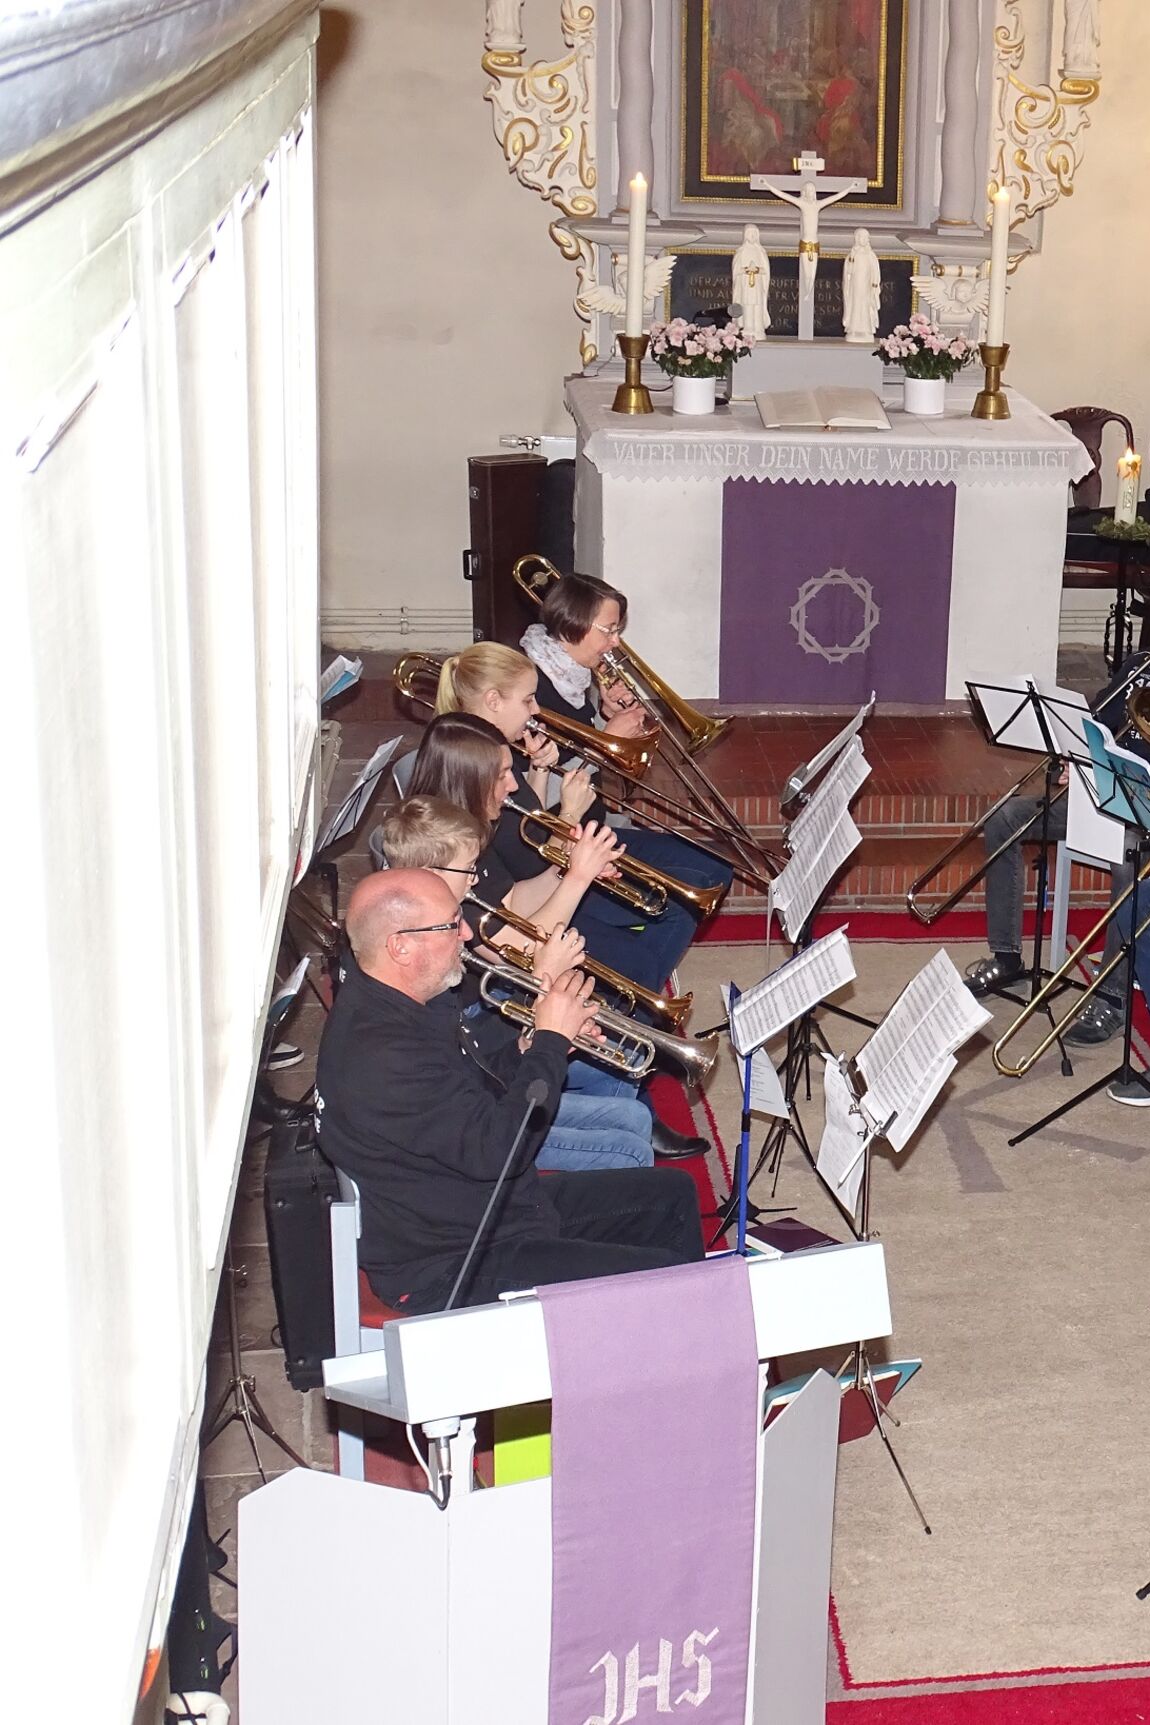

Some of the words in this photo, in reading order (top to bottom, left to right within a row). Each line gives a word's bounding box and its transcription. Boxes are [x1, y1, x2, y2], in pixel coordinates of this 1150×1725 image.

[614, 443, 675, 465] VATER
[684, 444, 750, 466] UNSER
[759, 446, 811, 470] DEIN
[819, 447, 878, 471] NAME
[888, 449, 960, 471] WERDE
